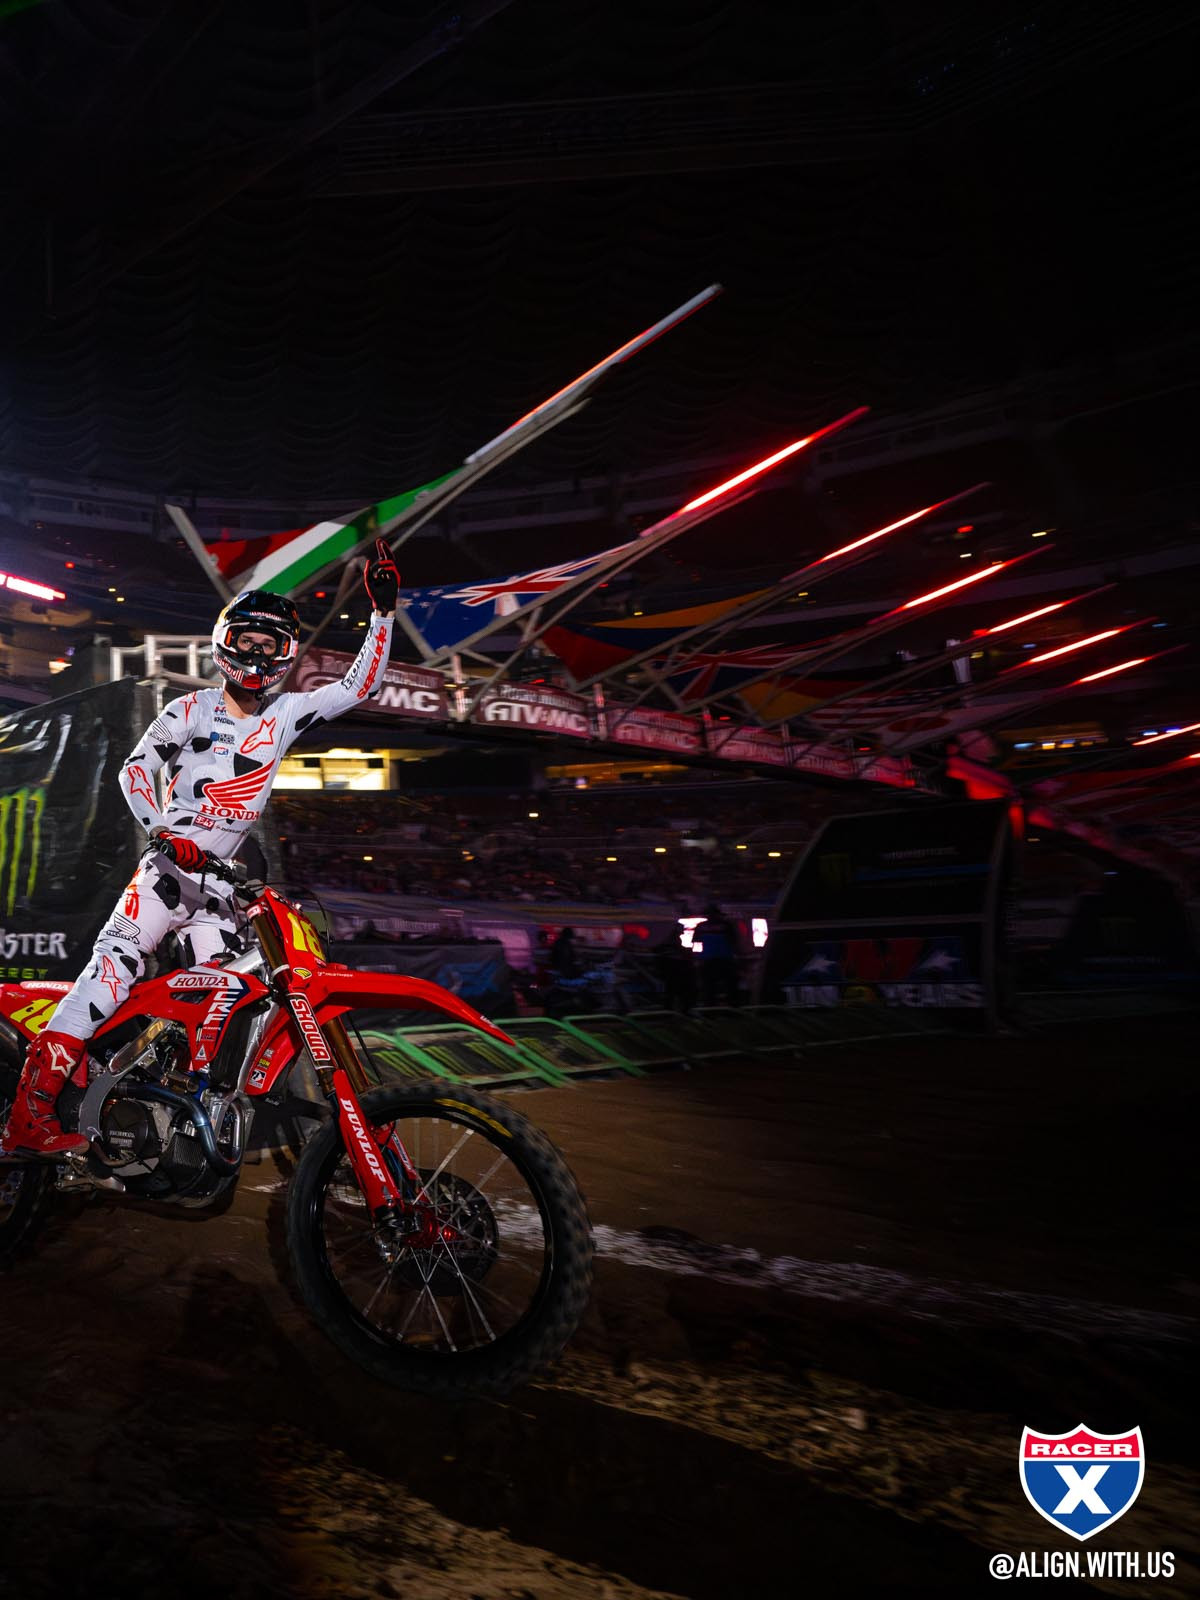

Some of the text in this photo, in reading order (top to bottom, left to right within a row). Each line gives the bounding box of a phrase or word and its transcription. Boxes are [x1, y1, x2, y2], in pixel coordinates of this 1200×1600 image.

[201, 804, 260, 821] HONDA
[26, 982, 69, 991] HONDA
[174, 976, 230, 987] HONDA
[203, 991, 240, 1026] CRF
[290, 998, 331, 1061] SHOWA
[340, 1098, 387, 1184] DUNLOP
